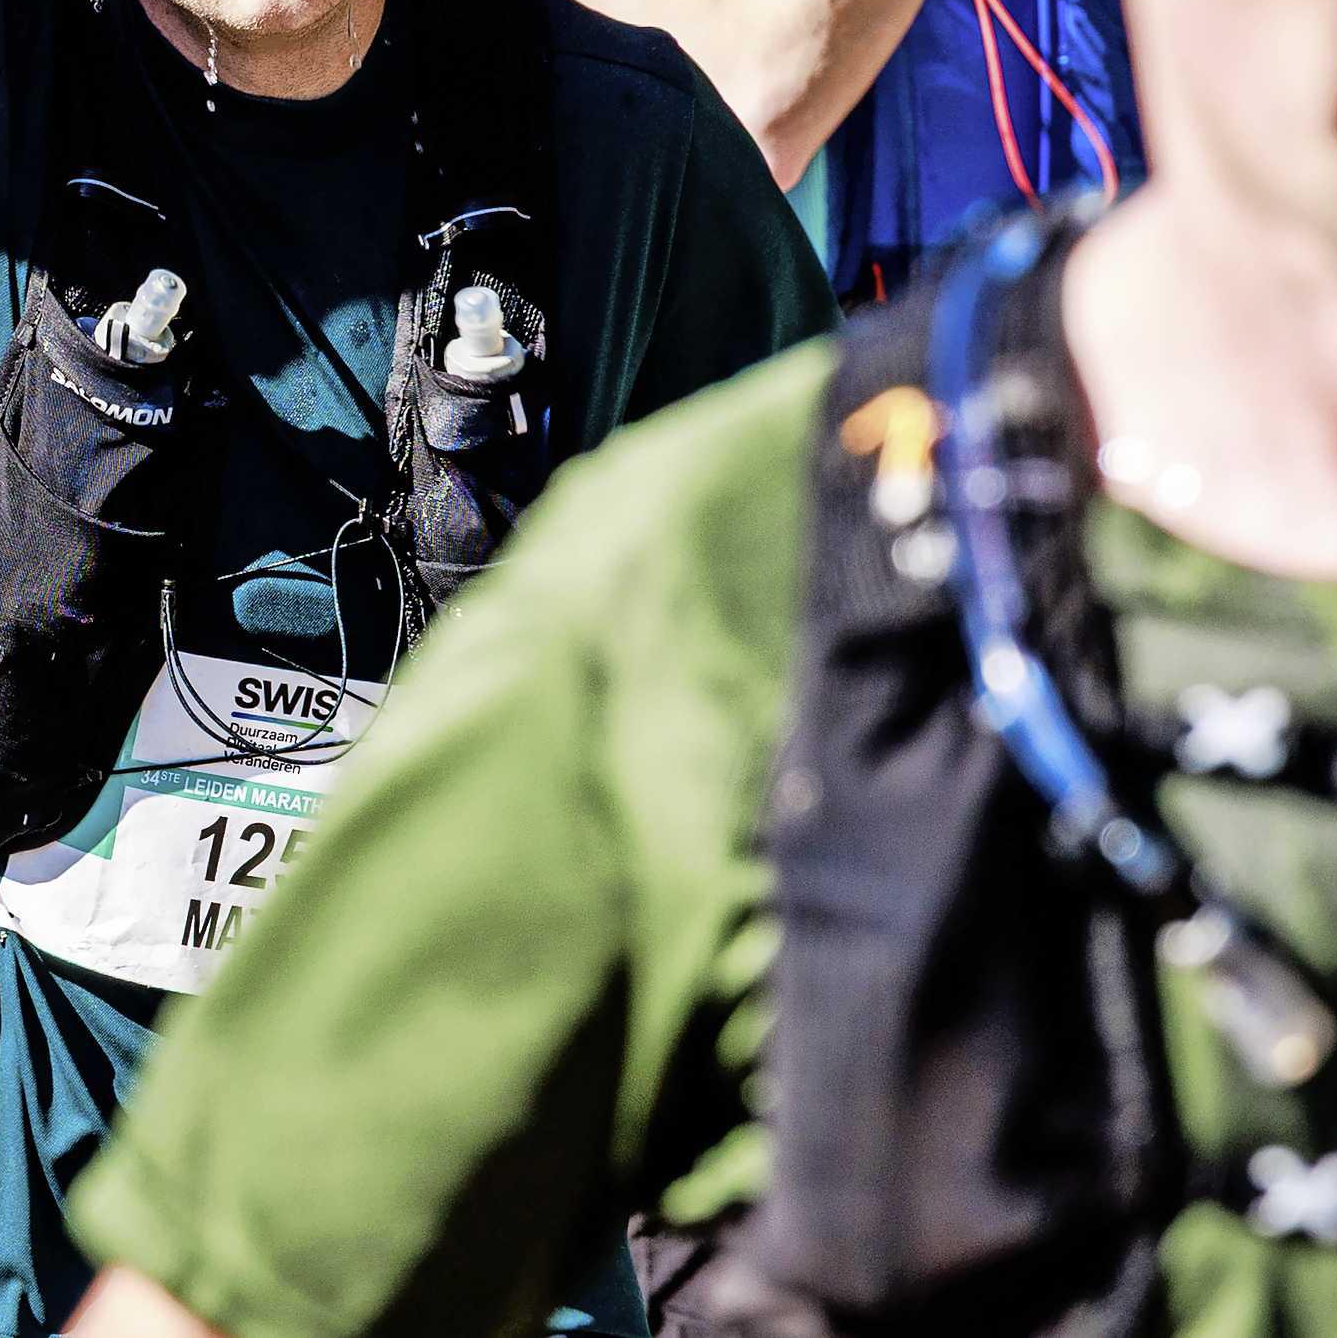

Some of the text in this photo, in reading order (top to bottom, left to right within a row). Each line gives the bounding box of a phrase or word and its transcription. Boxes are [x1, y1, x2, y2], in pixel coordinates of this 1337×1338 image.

[50, 366, 173, 426] SALOMON
[234, 676, 341, 721] SWIS
[229, 722, 299, 745] Duurzaam
[223, 750, 302, 775] Veranderen
[183, 775, 247, 804] LEIDEN
[251, 786, 326, 815] MARATH
[181, 898, 264, 951] MA
